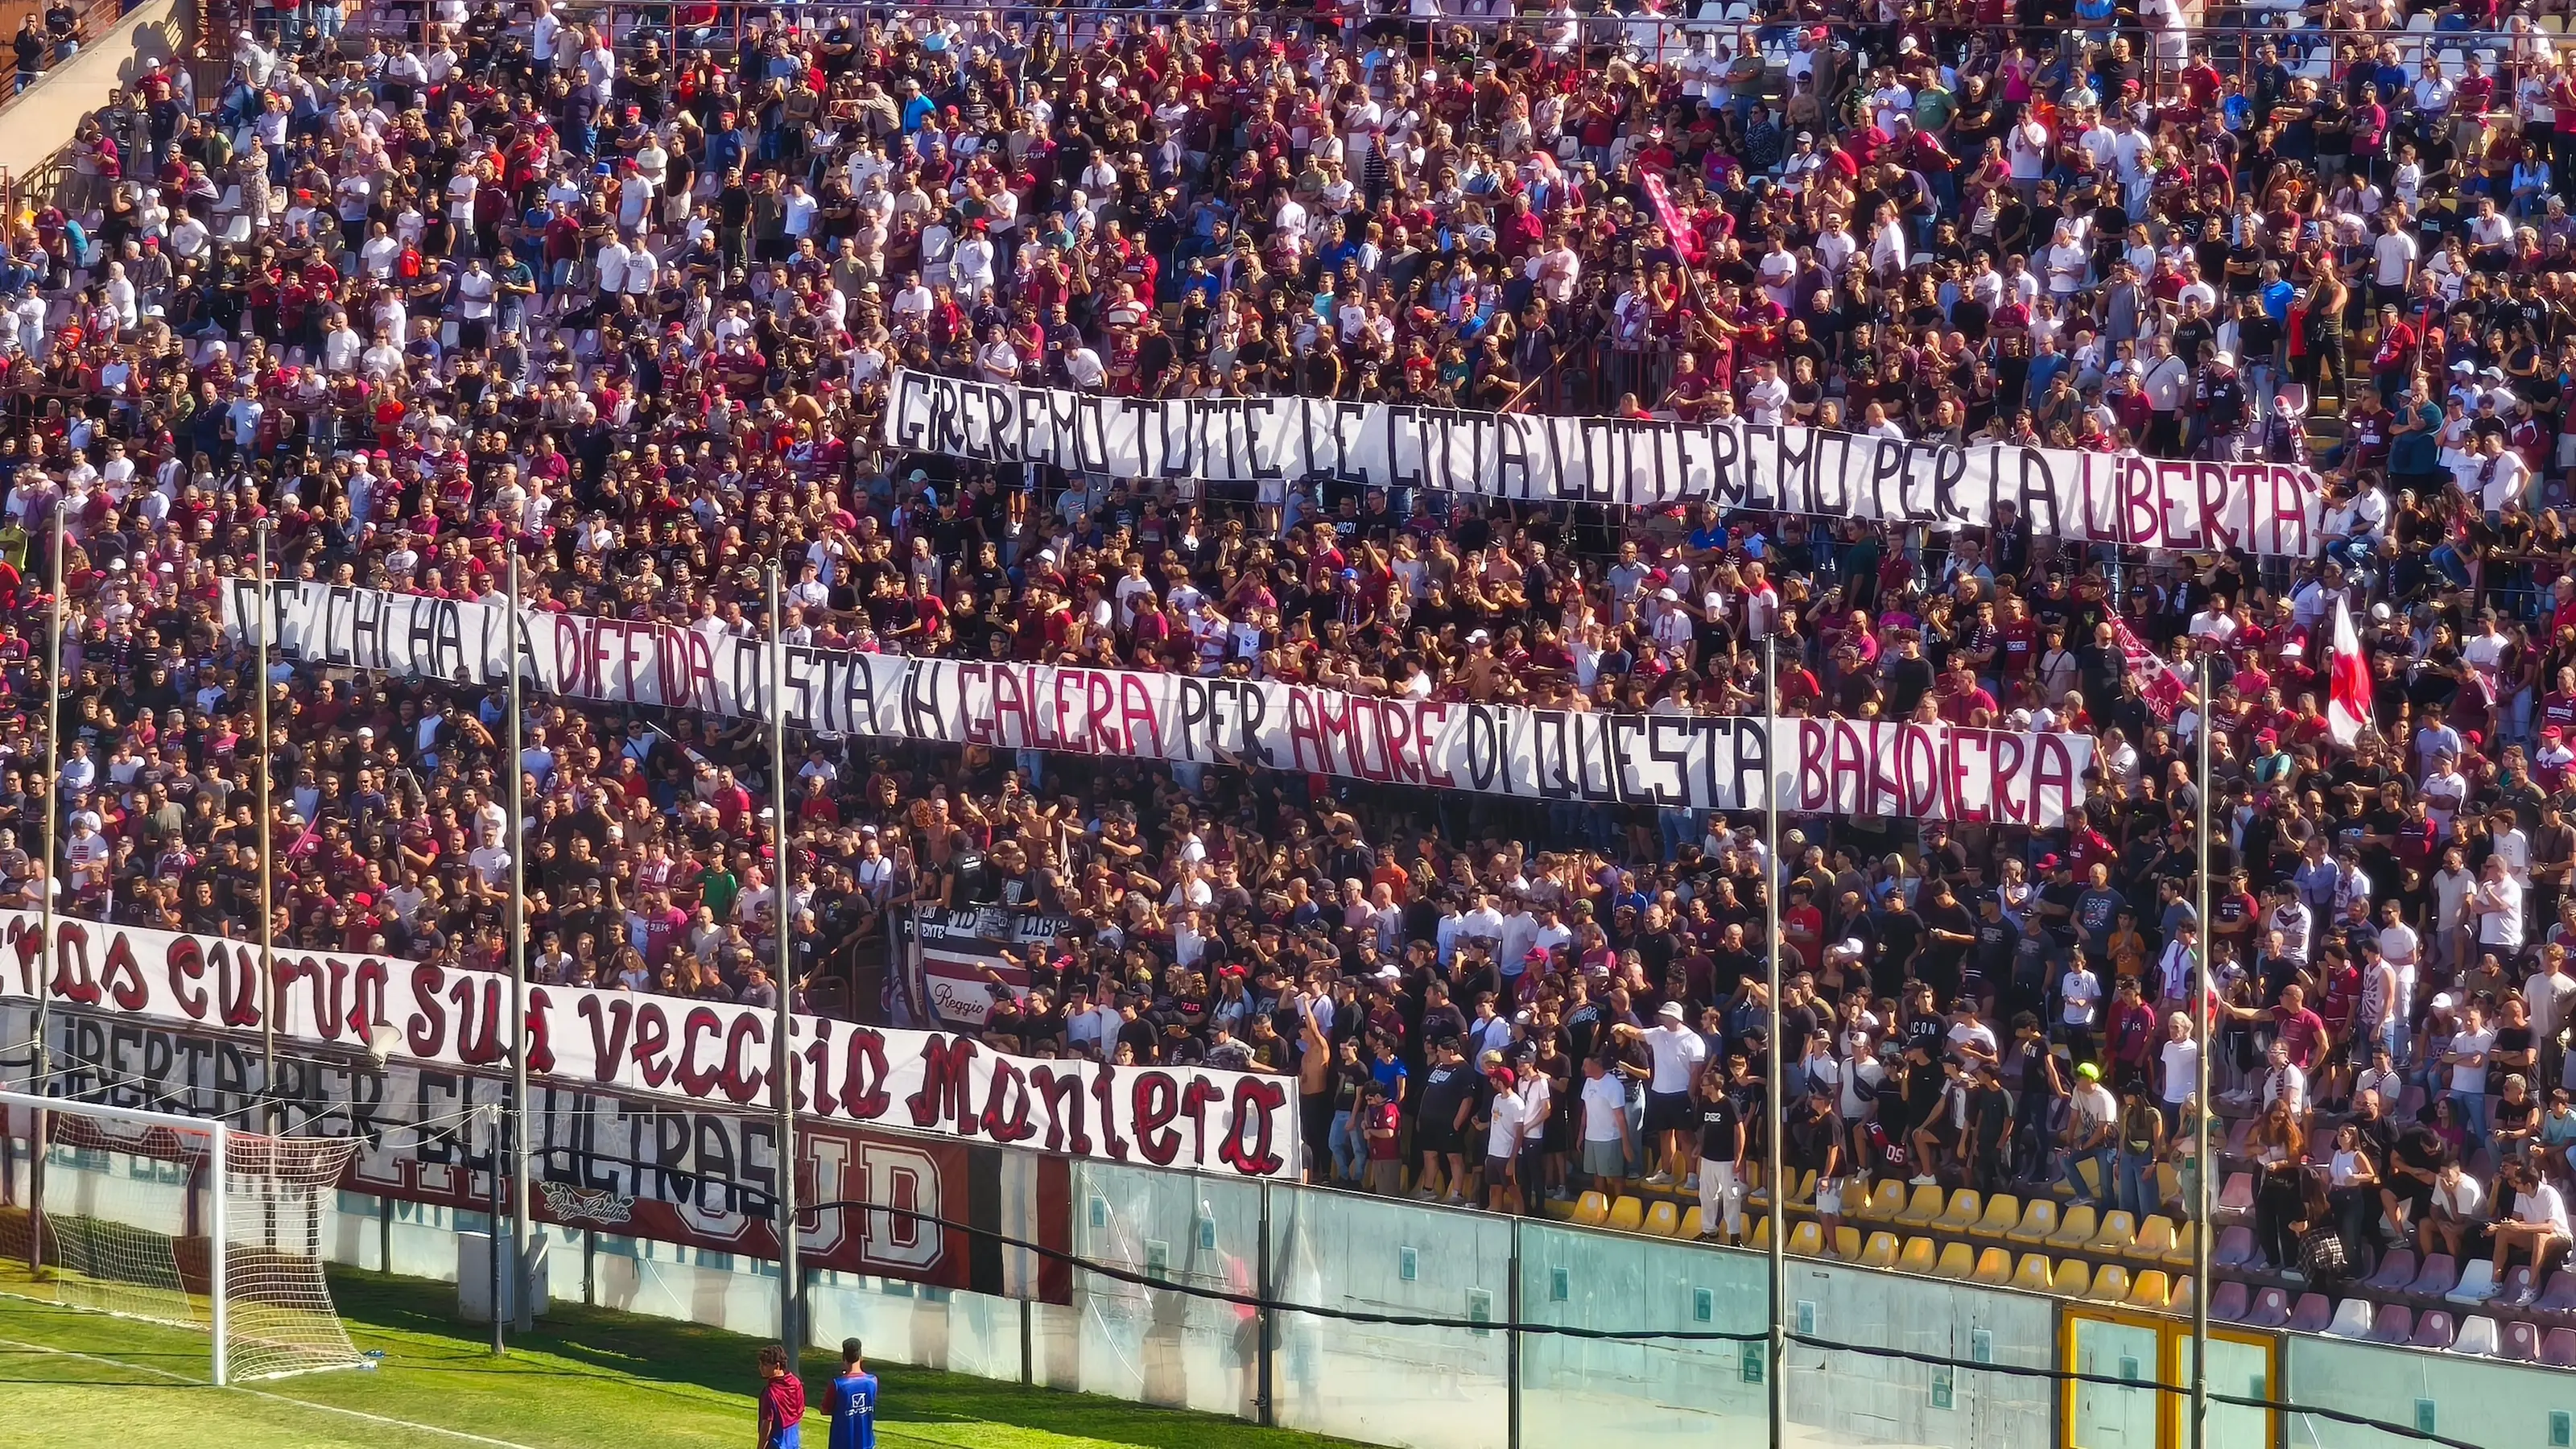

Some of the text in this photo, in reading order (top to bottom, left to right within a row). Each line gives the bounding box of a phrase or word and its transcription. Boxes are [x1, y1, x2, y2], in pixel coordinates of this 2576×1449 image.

[1122, 399, 1282, 480] TUTTE
[1302, 399, 1362, 482] LE
[1551, 415, 1852, 515] LOTTEREMO
[1872, 438, 1969, 522] PER
[409, 600, 462, 677] HA
[734, 638, 762, 719] O
[783, 647, 881, 735] STA
[958, 664, 1162, 758] GALERA
[1180, 678, 1274, 766] PER
[1288, 687, 1455, 787] AMORE
[1533, 710, 1767, 808] QUESTA
[0, 914, 149, 1011] ras
[935, 982, 985, 1016] Reggio
[1910, 1021, 1937, 1036] ICON
[543, 1086, 782, 1220] ULTRAS
